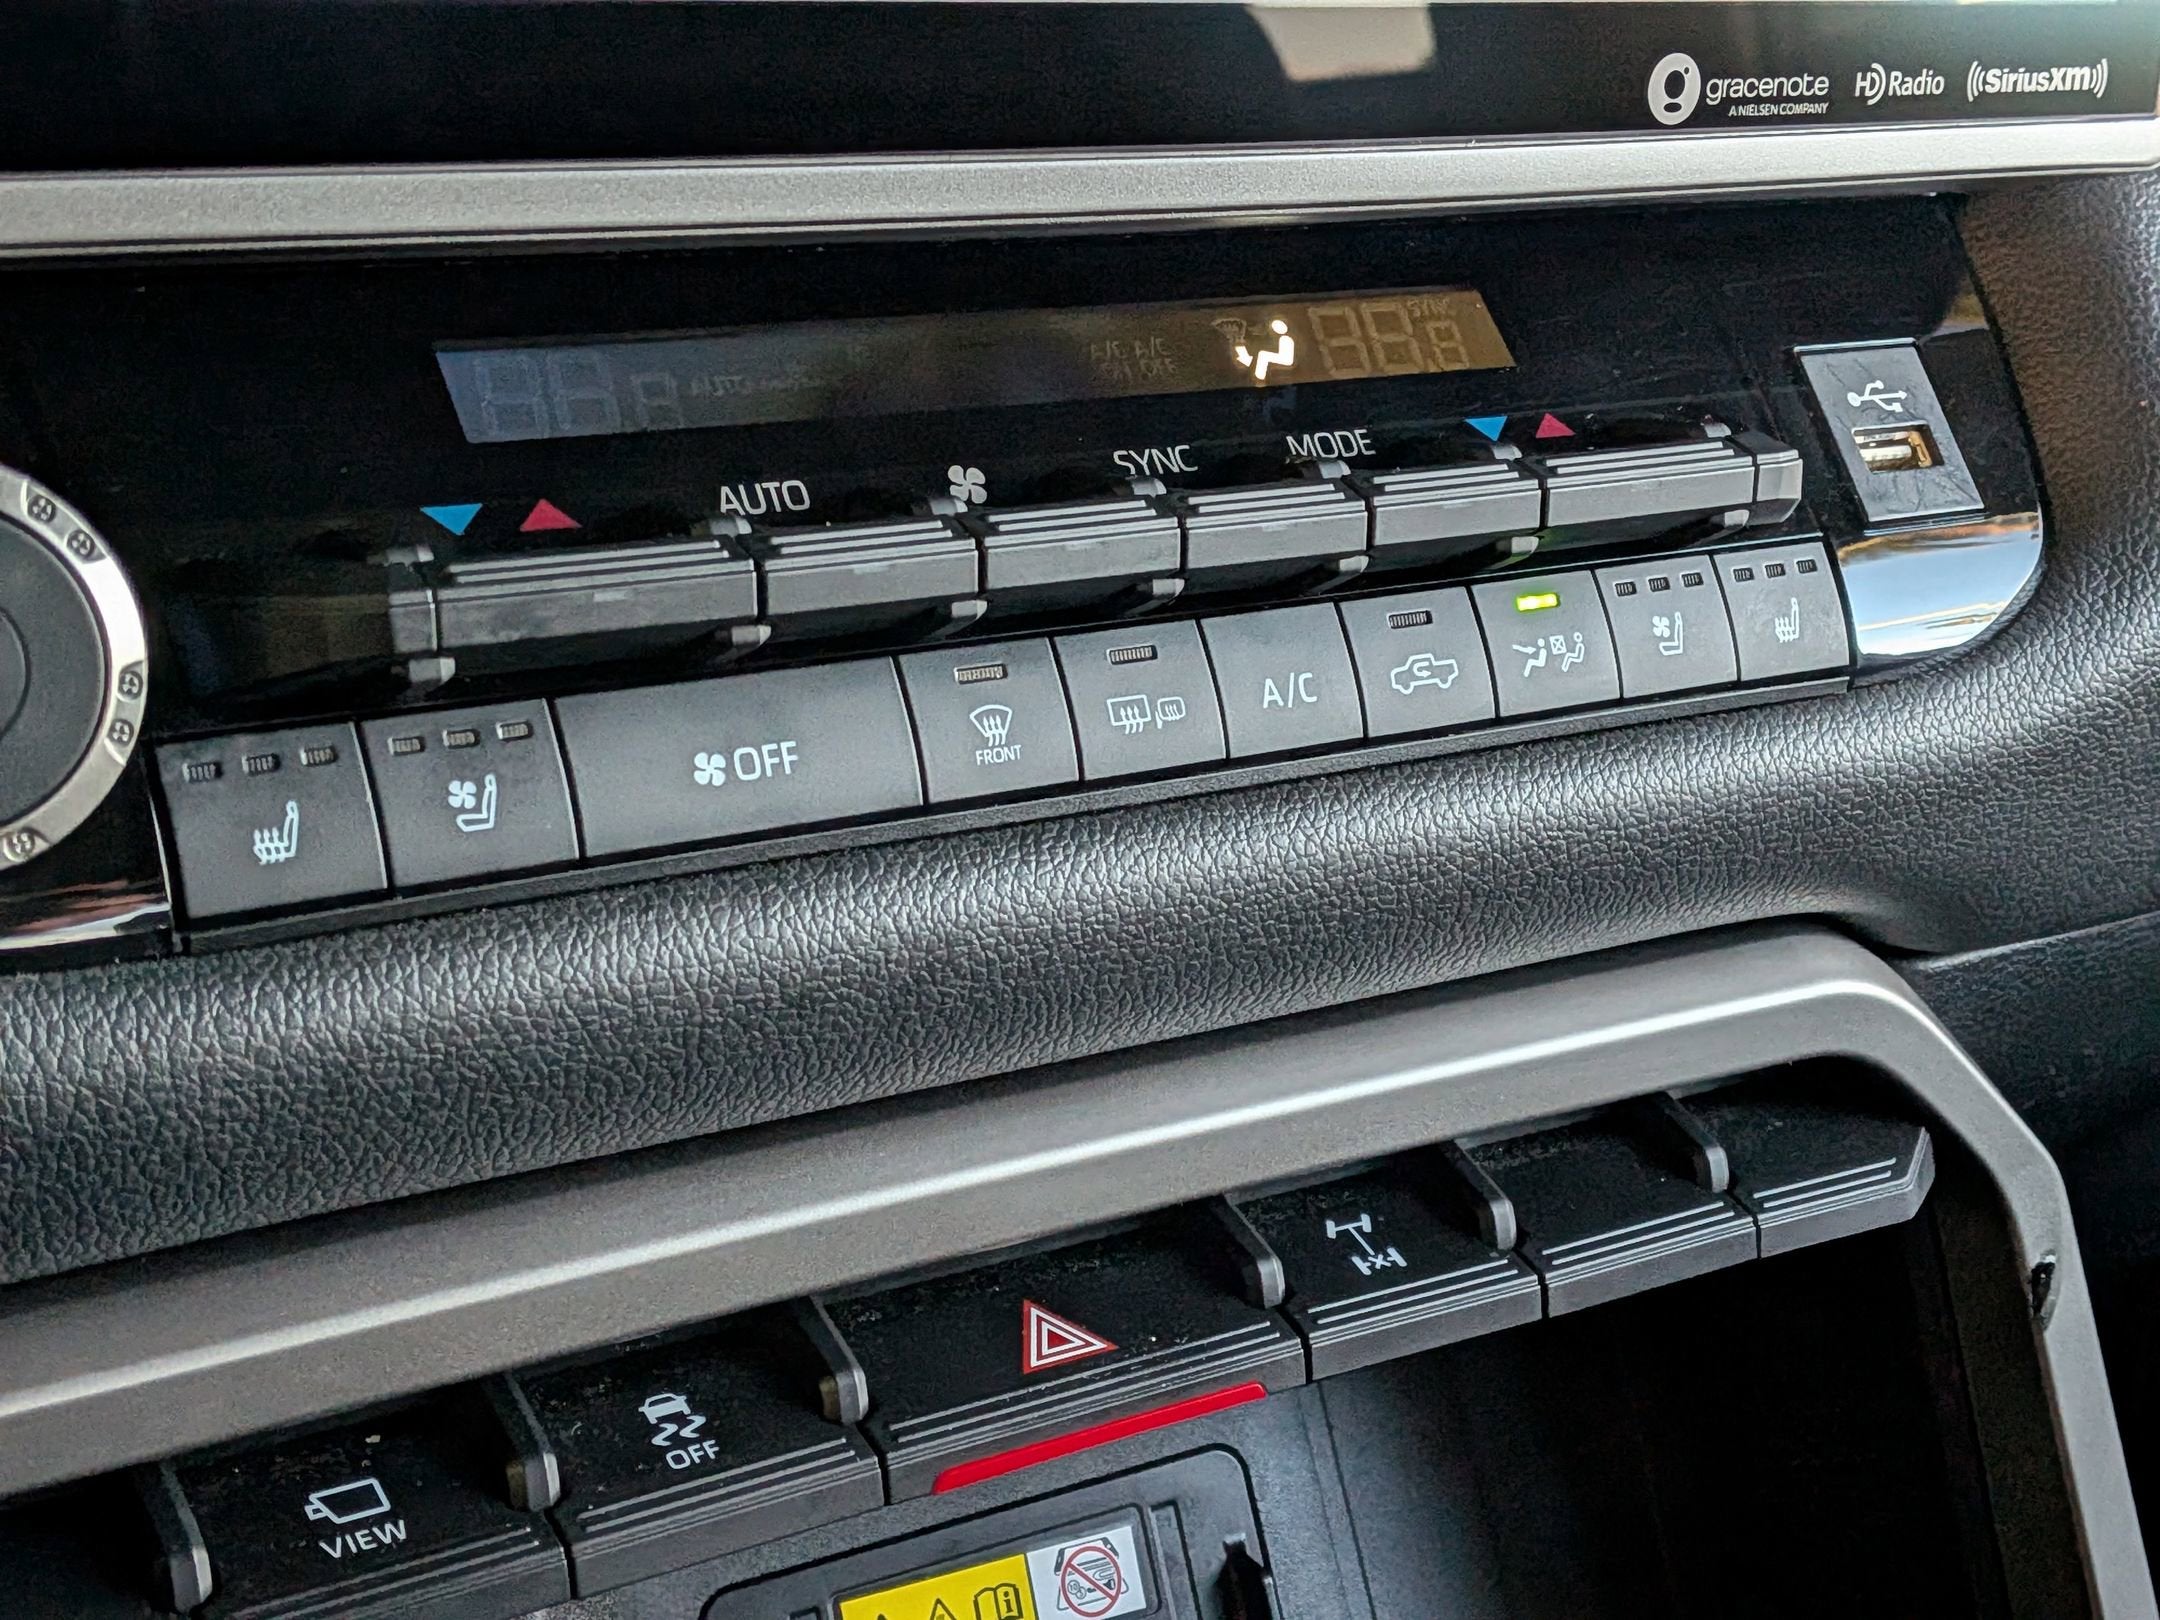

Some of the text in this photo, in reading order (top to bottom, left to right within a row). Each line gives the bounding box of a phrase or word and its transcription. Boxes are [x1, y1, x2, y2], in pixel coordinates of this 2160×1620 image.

[1706, 73, 1829, 106] gracenote
[1855, 66, 1944, 102] HD Radio
[1728, 102, 1829, 117] A NIELSEN COMPANY
[1114, 445, 1198, 475] SYNC
[1286, 430, 1376, 458] MODE
[720, 479, 810, 515] AUTO
[1262, 672, 1317, 708] A/C
[733, 741, 799, 781] OFF
[976, 744, 1021, 766] FRONT
[666, 1439, 720, 1470] OFF
[319, 1518, 408, 1559] VIEW
